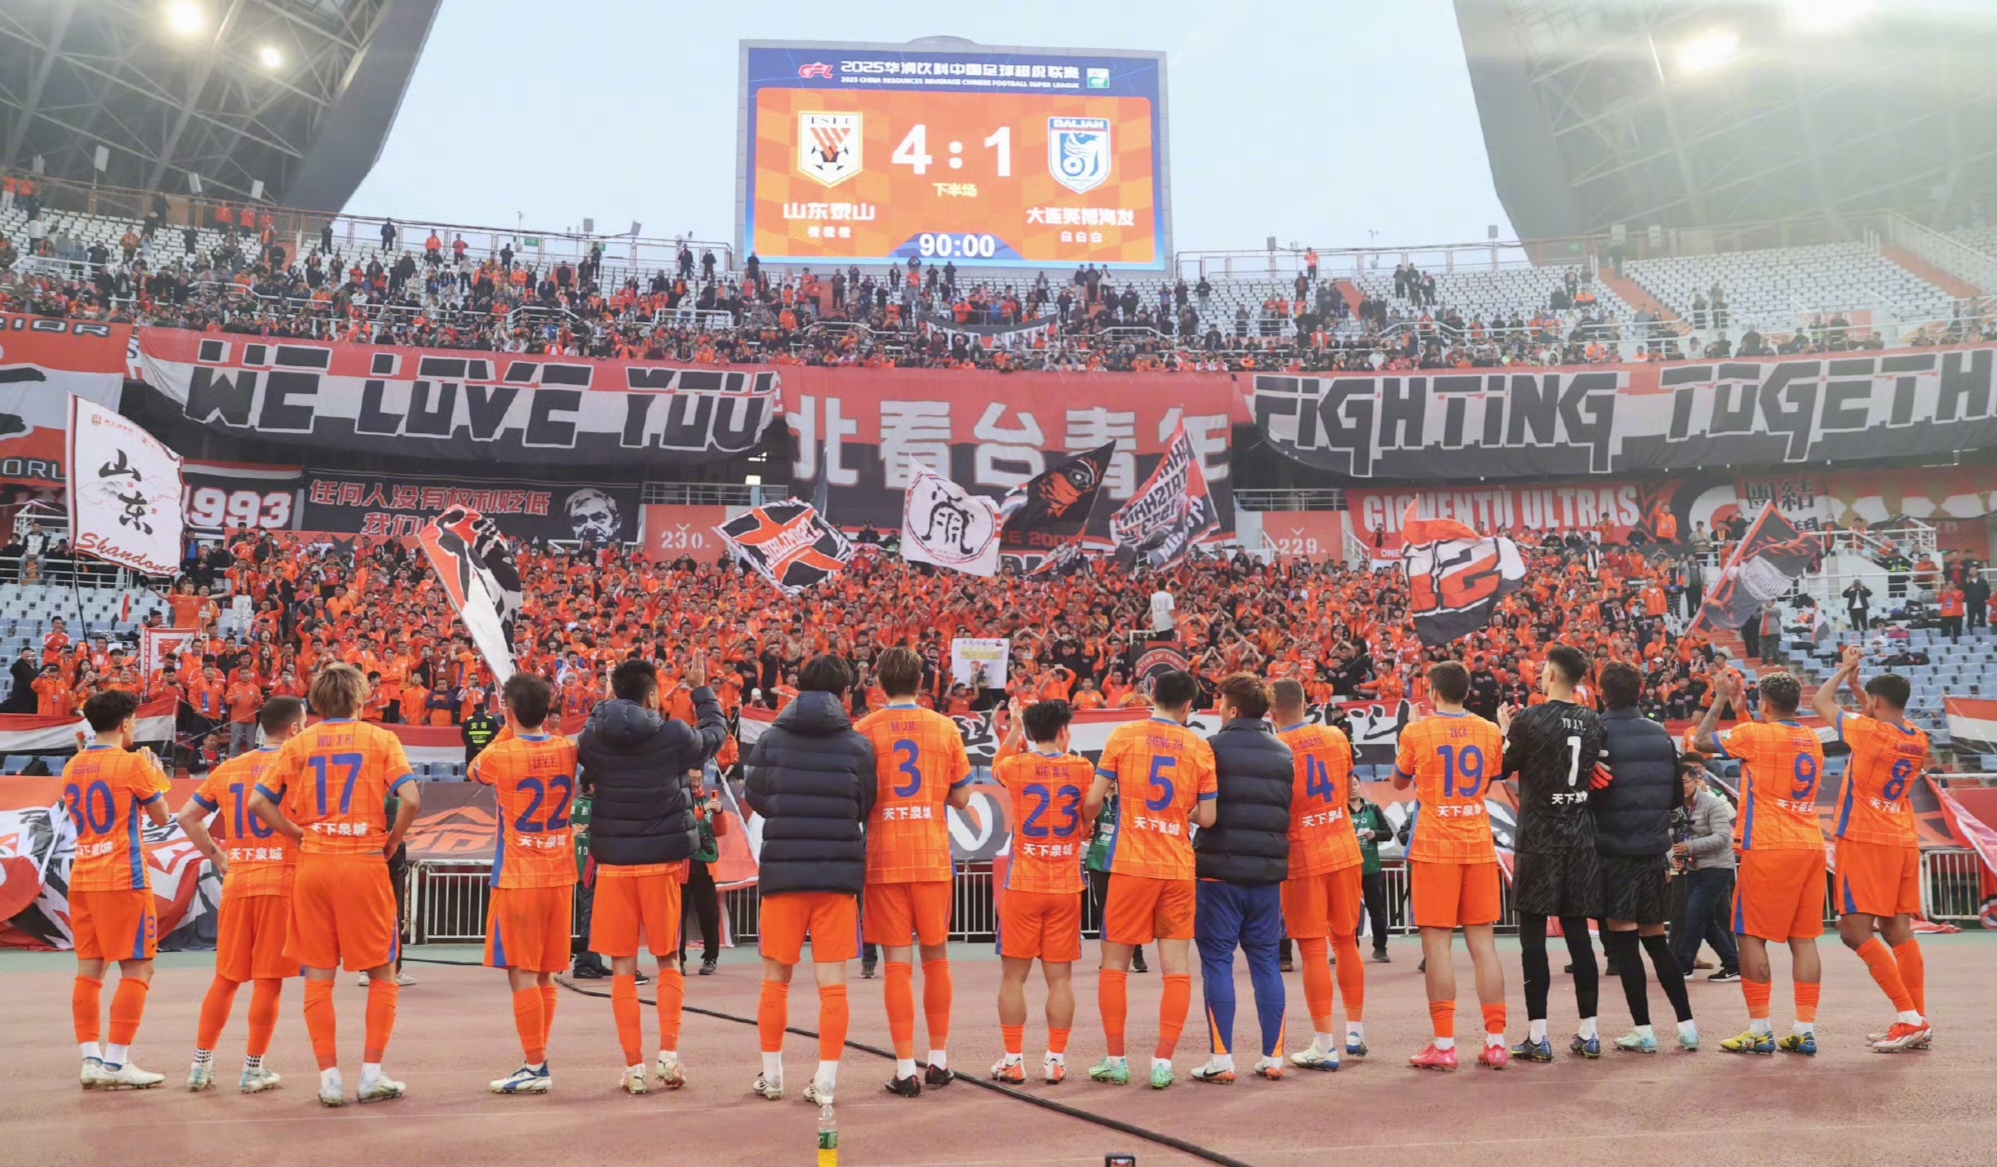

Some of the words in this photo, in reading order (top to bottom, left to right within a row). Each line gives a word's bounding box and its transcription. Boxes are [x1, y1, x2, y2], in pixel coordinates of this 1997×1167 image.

[783, 202, 875, 220] 山东泰山
[932, 182, 978, 197] 下半场
[919, 234, 996, 258] 90:00
[0, 317, 109, 336] IOR
[183, 339, 333, 433] WE
[1254, 371, 1618, 477] FIGHTING
[787, 394, 1231, 500] 北看台青年
[310, 479, 552, 516] 任何人没有权利贬低
[1521, 485, 1641, 531] ULTRAS
[76, 532, 181, 577] Shandong
[661, 530, 704, 549] 230
[1279, 537, 1318, 555] 229
[893, 739, 922, 798] 3
[1146, 755, 1176, 811] 5
[1306, 754, 1335, 802] 4
[1437, 744, 1484, 797] 19
[1567, 736, 1581, 786] 1
[1792, 752, 1817, 801] 9
[1883, 758, 1912, 801] 8
[308, 753, 363, 816] 17
[515, 775, 572, 832] 22
[65, 779, 115, 836] 30
[311, 822, 369, 836] 天下泉城
[883, 806, 932, 820] 天下泉城
[1023, 783, 1081, 838] 23
[231, 847, 283, 861] 天下泉城
[577, 845, 588, 856] 10
[1023, 842, 1073, 857] 天下泉城
